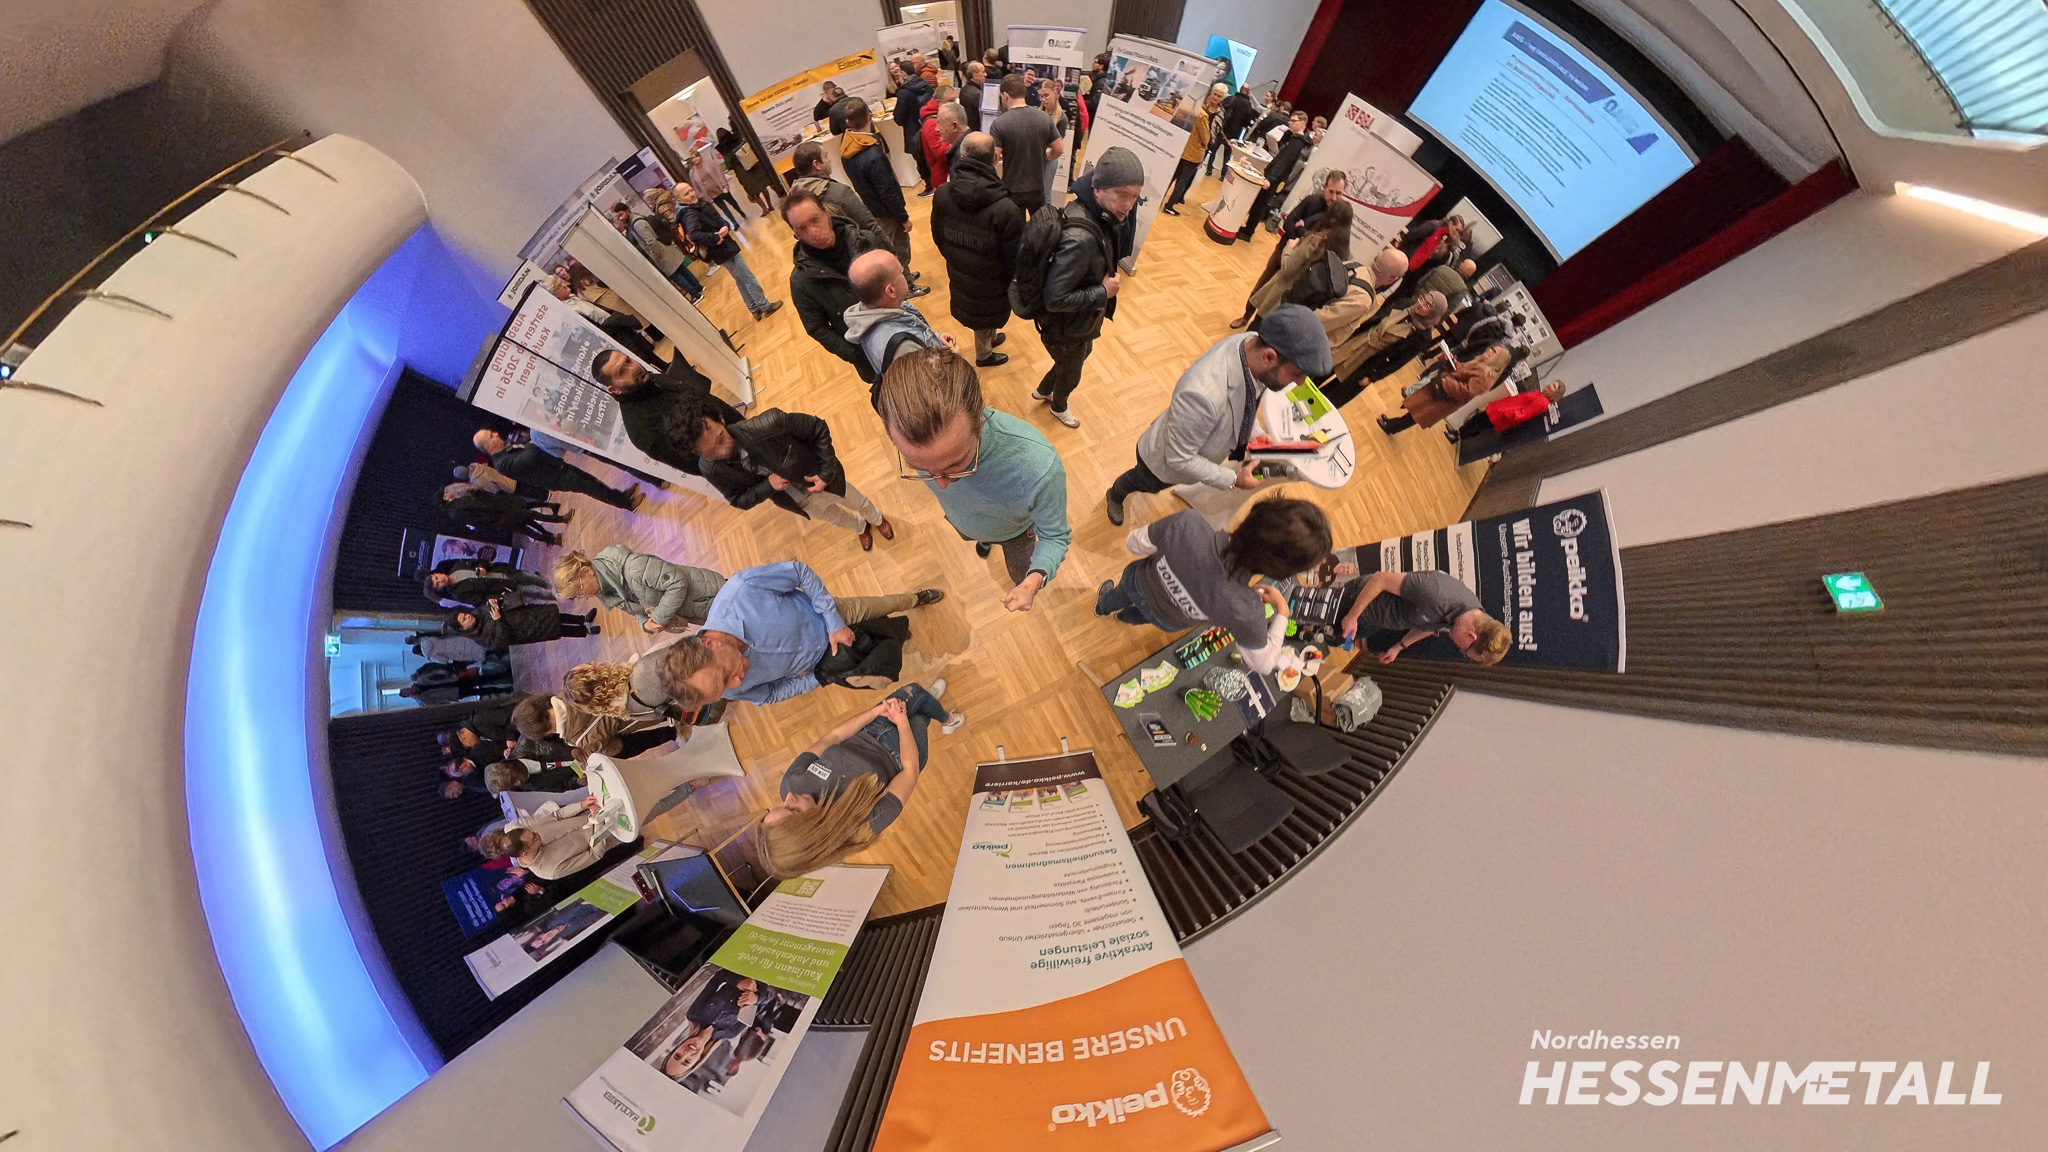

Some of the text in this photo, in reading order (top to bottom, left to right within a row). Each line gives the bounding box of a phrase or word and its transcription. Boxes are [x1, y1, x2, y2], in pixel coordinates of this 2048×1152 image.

[838, 56, 862, 70] Esterer
[593, 169, 619, 194] JORDAN
[510, 267, 530, 294] JORDAN
[1455, 533, 1464, 581] Industriekau
[1158, 563, 1181, 596] JOIN
[1497, 523, 1512, 629] Unsere Ausbildungsbe
[1512, 518, 1537, 650] Wir bilden aus!
[1559, 537, 1585, 620] peikko
[1005, 846, 1117, 869] Gesundheitsmaßnahmen
[748, 941, 830, 968] und Außenhandels-
[779, 938, 835, 957] management
[1029, 940, 1153, 970] Attraktive freiwillige
[1038, 929, 1149, 957] soziale Leistungen
[735, 950, 823, 981] Kaufmann für Groß-
[928, 1016, 1187, 1063] UNSERE BENEFITS
[1049, 1080, 1168, 1127] peikko
